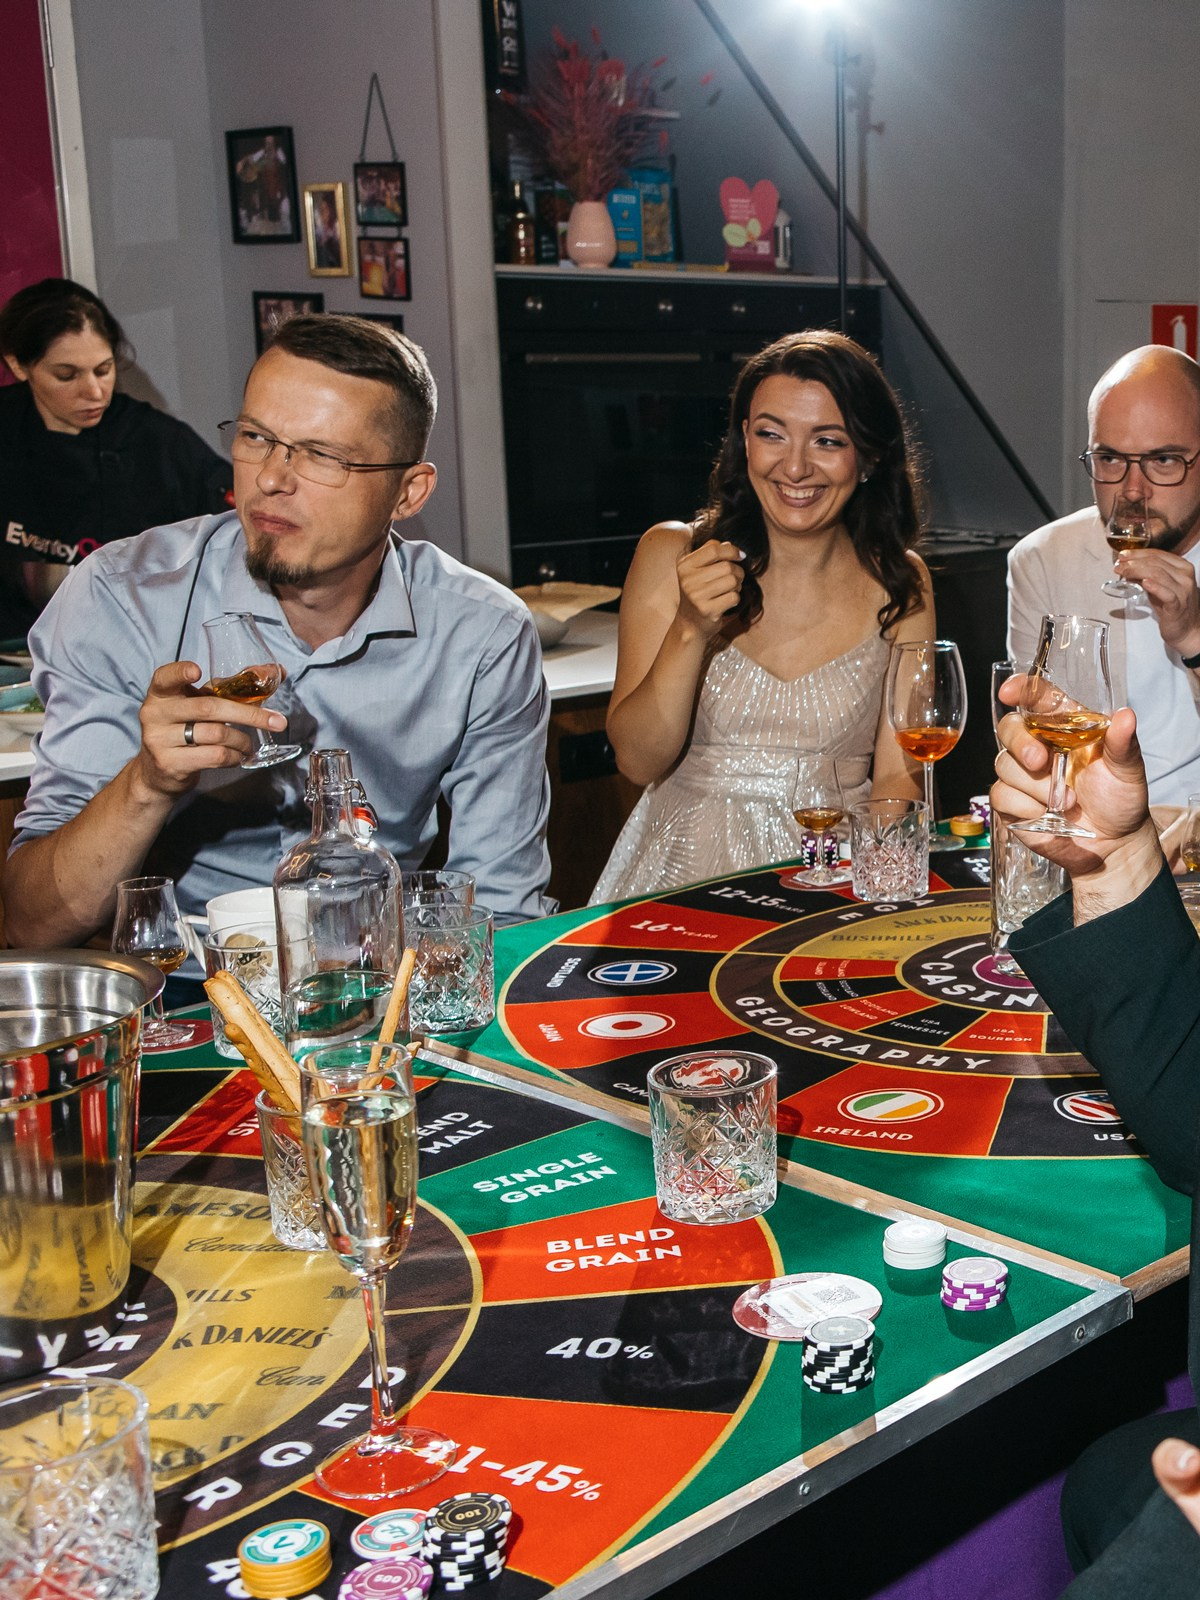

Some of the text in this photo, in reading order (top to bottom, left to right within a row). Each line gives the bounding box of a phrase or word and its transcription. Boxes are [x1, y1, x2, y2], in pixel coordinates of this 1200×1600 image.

[708, 886, 786, 907] 12-15
[630, 920, 685, 933] 16+
[831, 934, 936, 942] BUSHMILLS
[921, 961, 1038, 1007] CASIN
[538, 1023, 564, 1042] JAPAN
[736, 996, 992, 1070] GEOGRAPHY
[889, 1020, 951, 1036] TENNESSEE
[968, 1034, 1033, 1043] BOURBON
[416, 1112, 470, 1140] END
[418, 1120, 495, 1155] MALT
[811, 1125, 914, 1141] IRELAND
[473, 1151, 603, 1194] SINGLE
[500, 1165, 617, 1204] GRAIN
[546, 1228, 675, 1254] BLEND
[545, 1245, 682, 1273] GRAIN
[546, 1336, 654, 1360] 40%
[373, 1573, 403, 1584] 500
